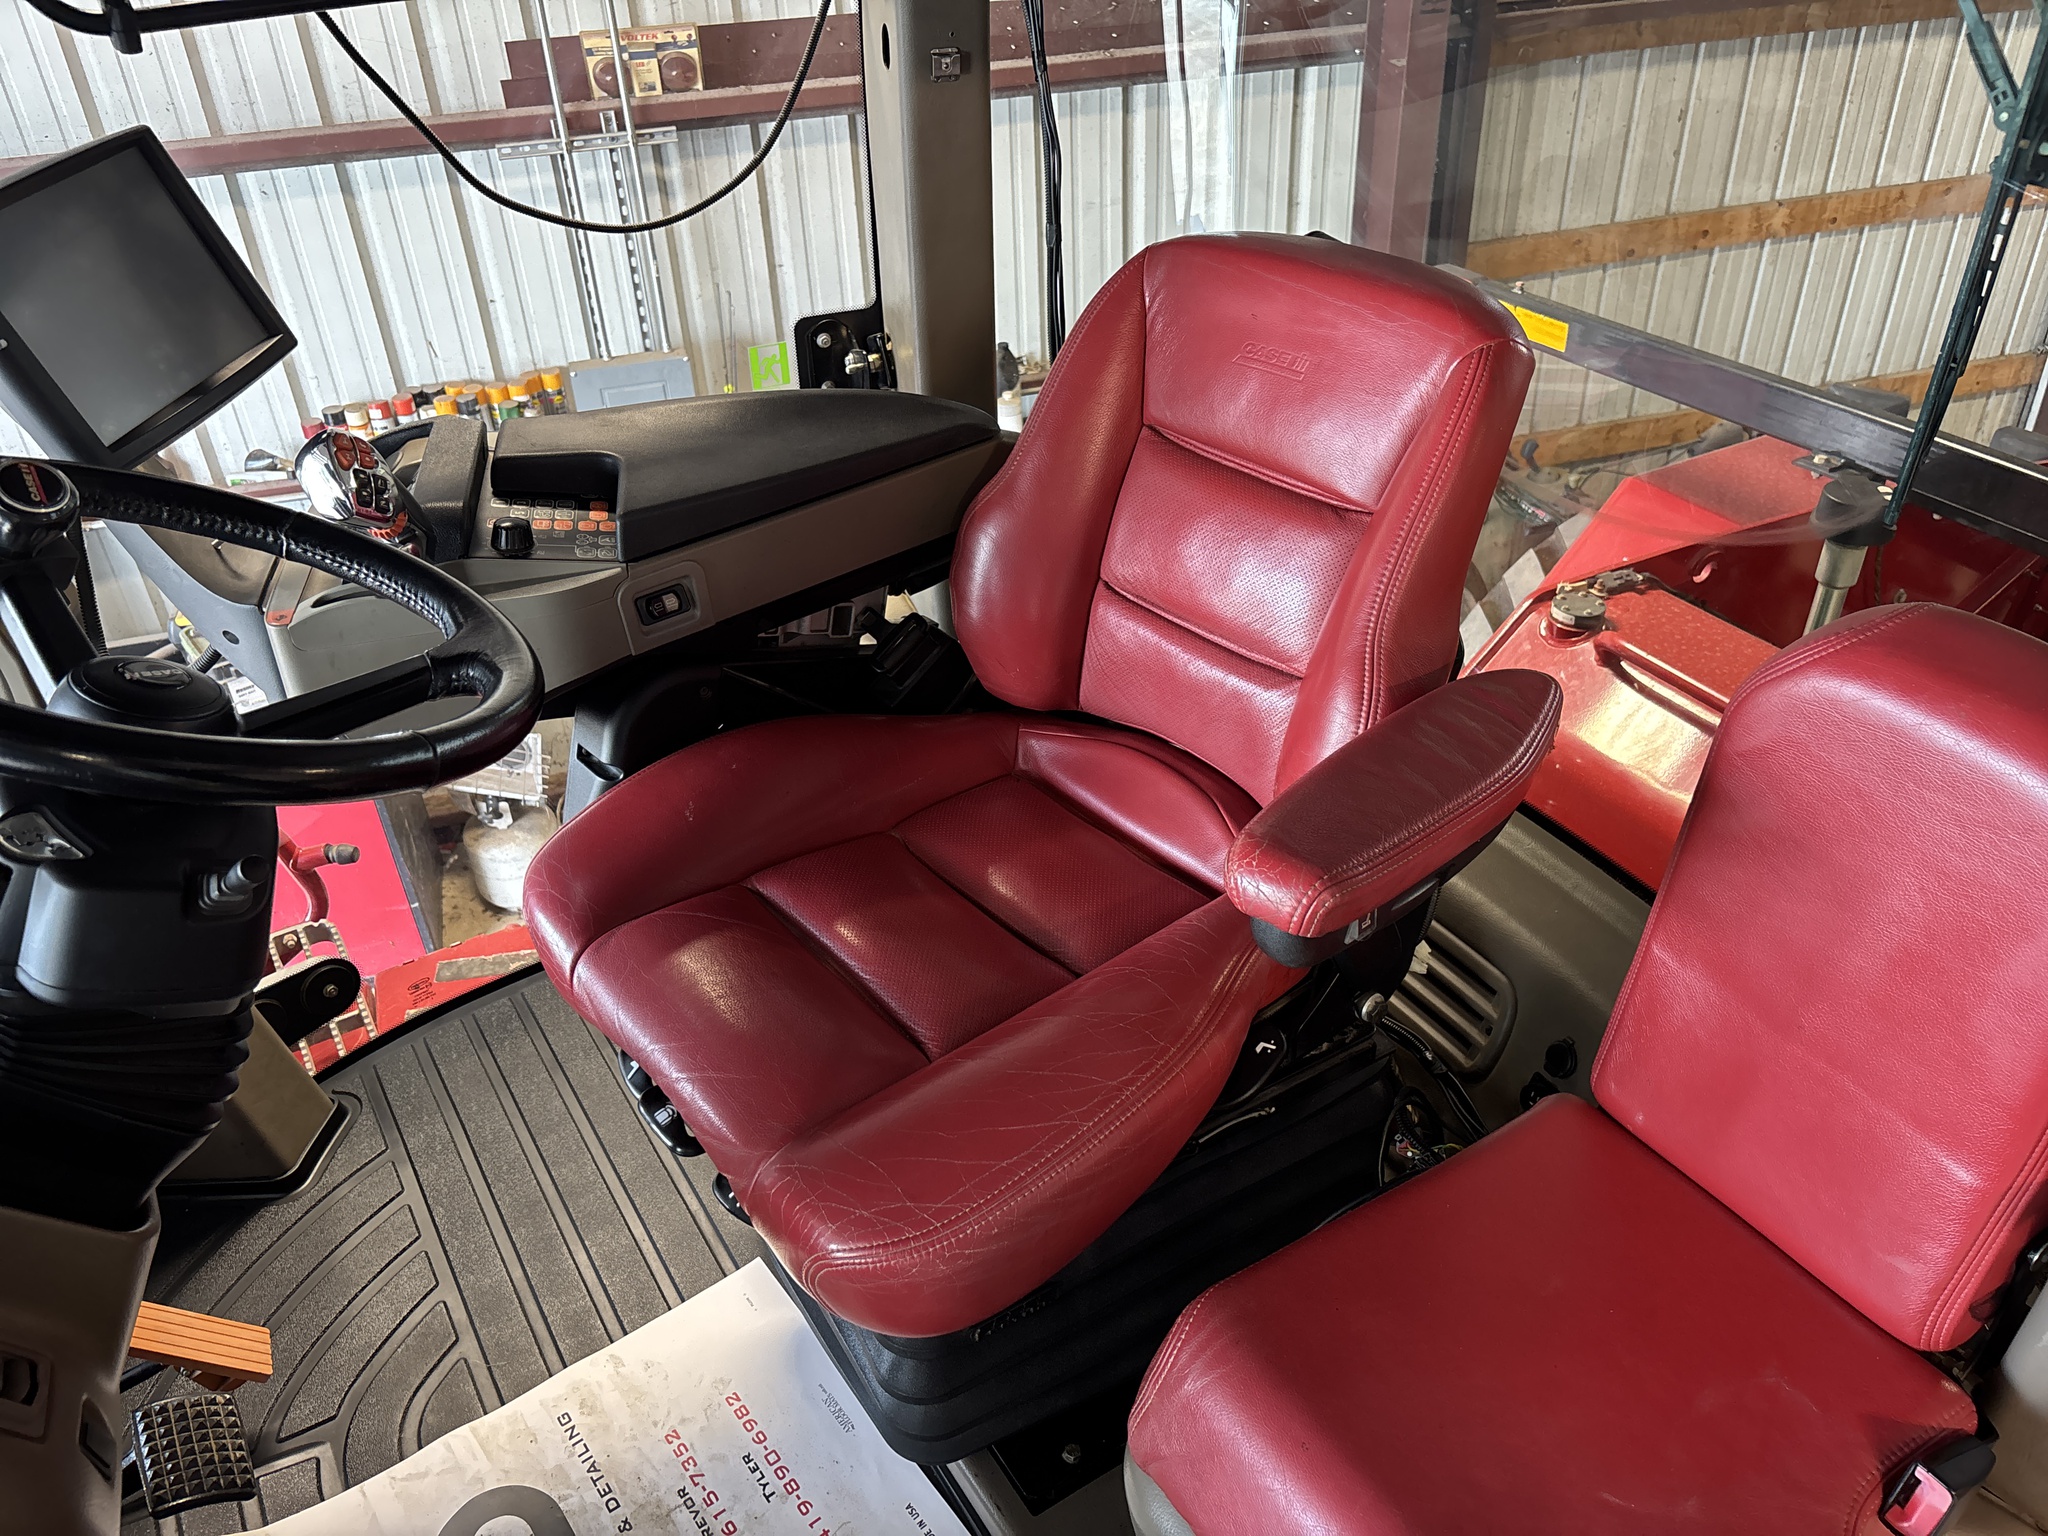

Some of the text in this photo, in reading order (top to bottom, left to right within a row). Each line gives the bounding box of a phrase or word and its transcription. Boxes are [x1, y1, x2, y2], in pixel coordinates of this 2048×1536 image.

[620, 32, 659, 41] VOLTEK
[556, 1411, 634, 1534] & DETAILING
[741, 1451, 776, 1504] TYLER
[905, 1502, 920, 1519] USA
[916, 1519, 928, 1530] IN
